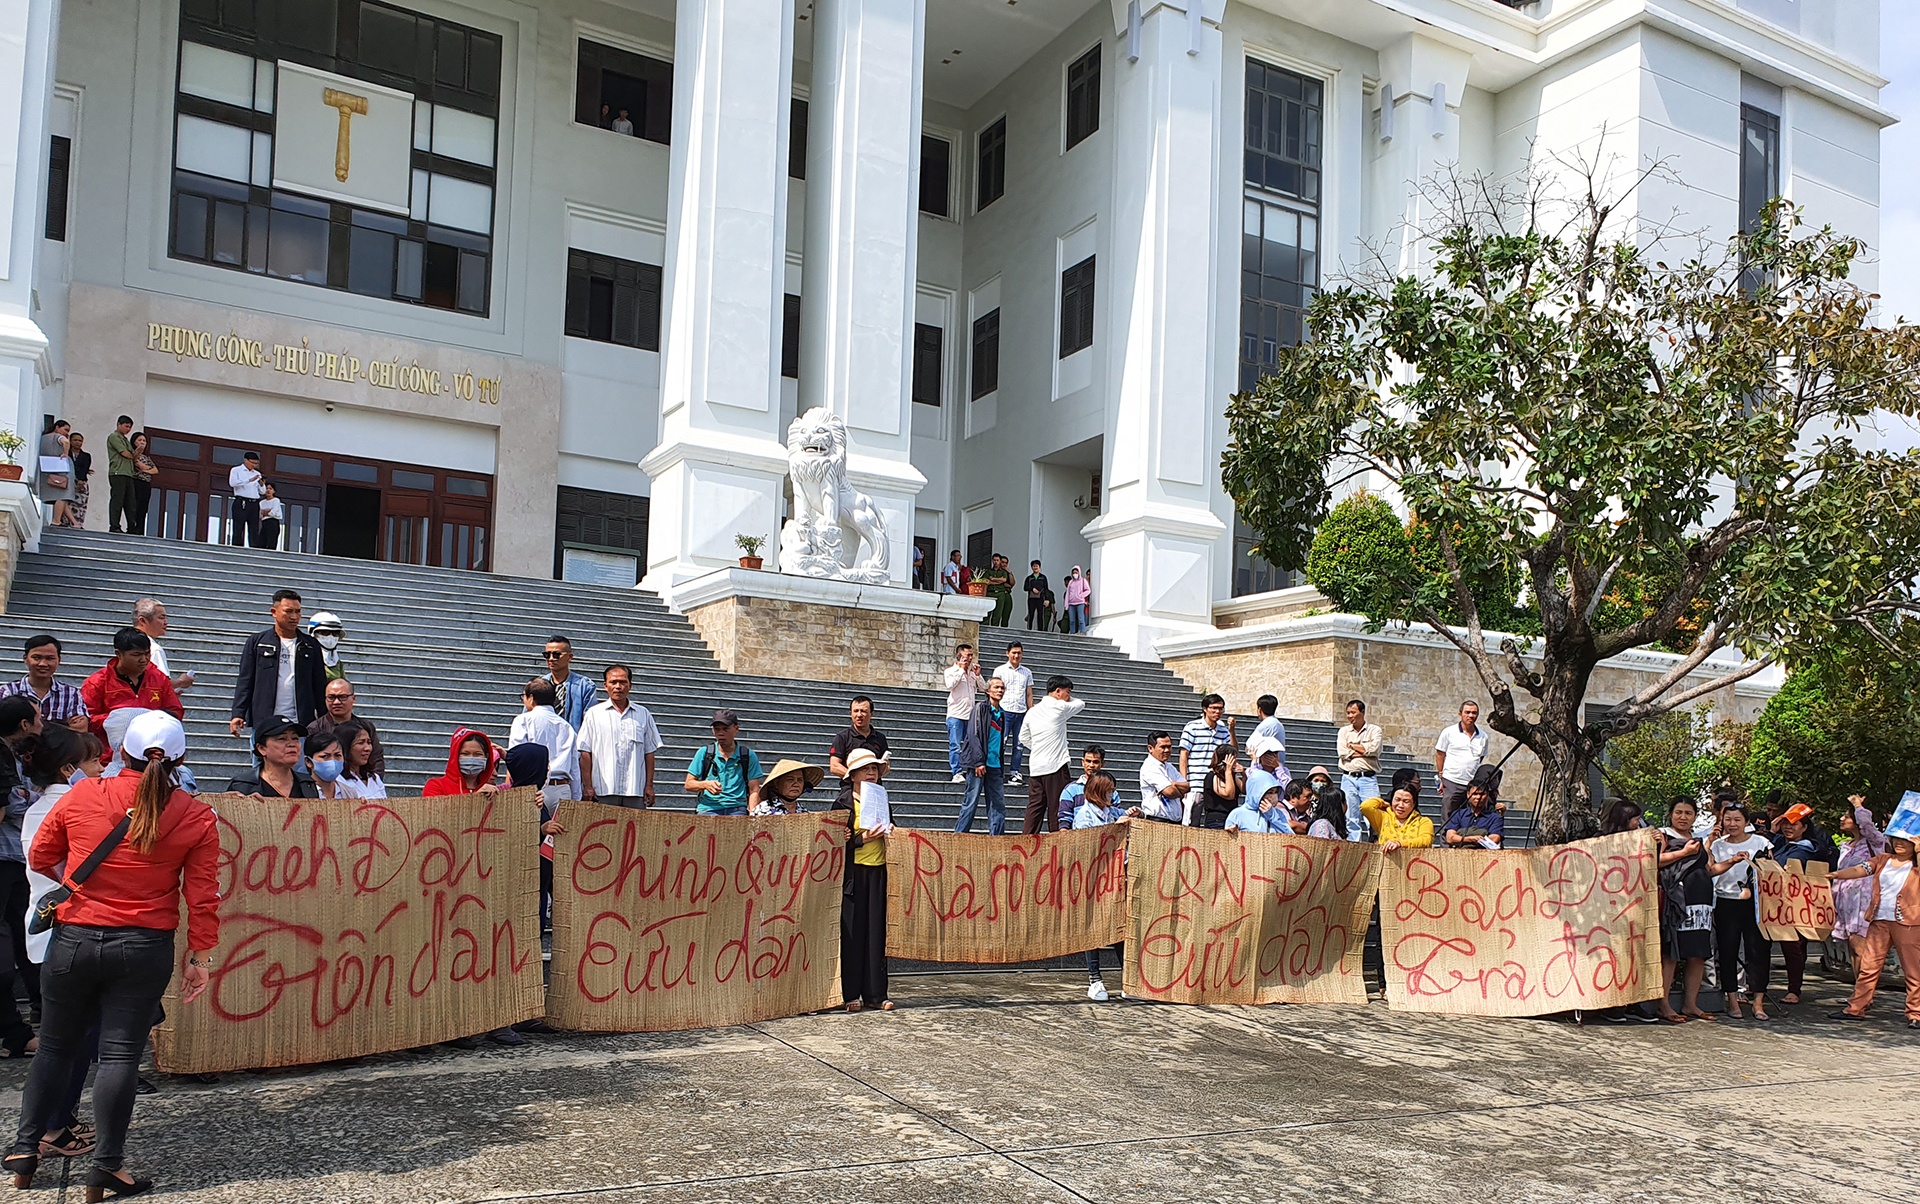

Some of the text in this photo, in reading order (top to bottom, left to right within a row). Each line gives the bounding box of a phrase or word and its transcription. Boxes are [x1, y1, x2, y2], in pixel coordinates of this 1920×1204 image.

[146, 322, 212, 362] PHỤNG
[215, 329, 262, 368] CÔNG
[272, 336, 310, 375] THỦ
[313, 347, 360, 384] PHÁP
[368, 356, 398, 390] CHÍ
[398, 358, 441, 396] CÔNG
[453, 367, 475, 401] VÔ
[478, 375, 502, 405] TƯ
[572, 818, 847, 912] Chính Quyền
[1395, 857, 1538, 932] Bách
[408, 889, 531, 998] dân
[714, 898, 812, 985] dân
[1259, 905, 1353, 985] dân
